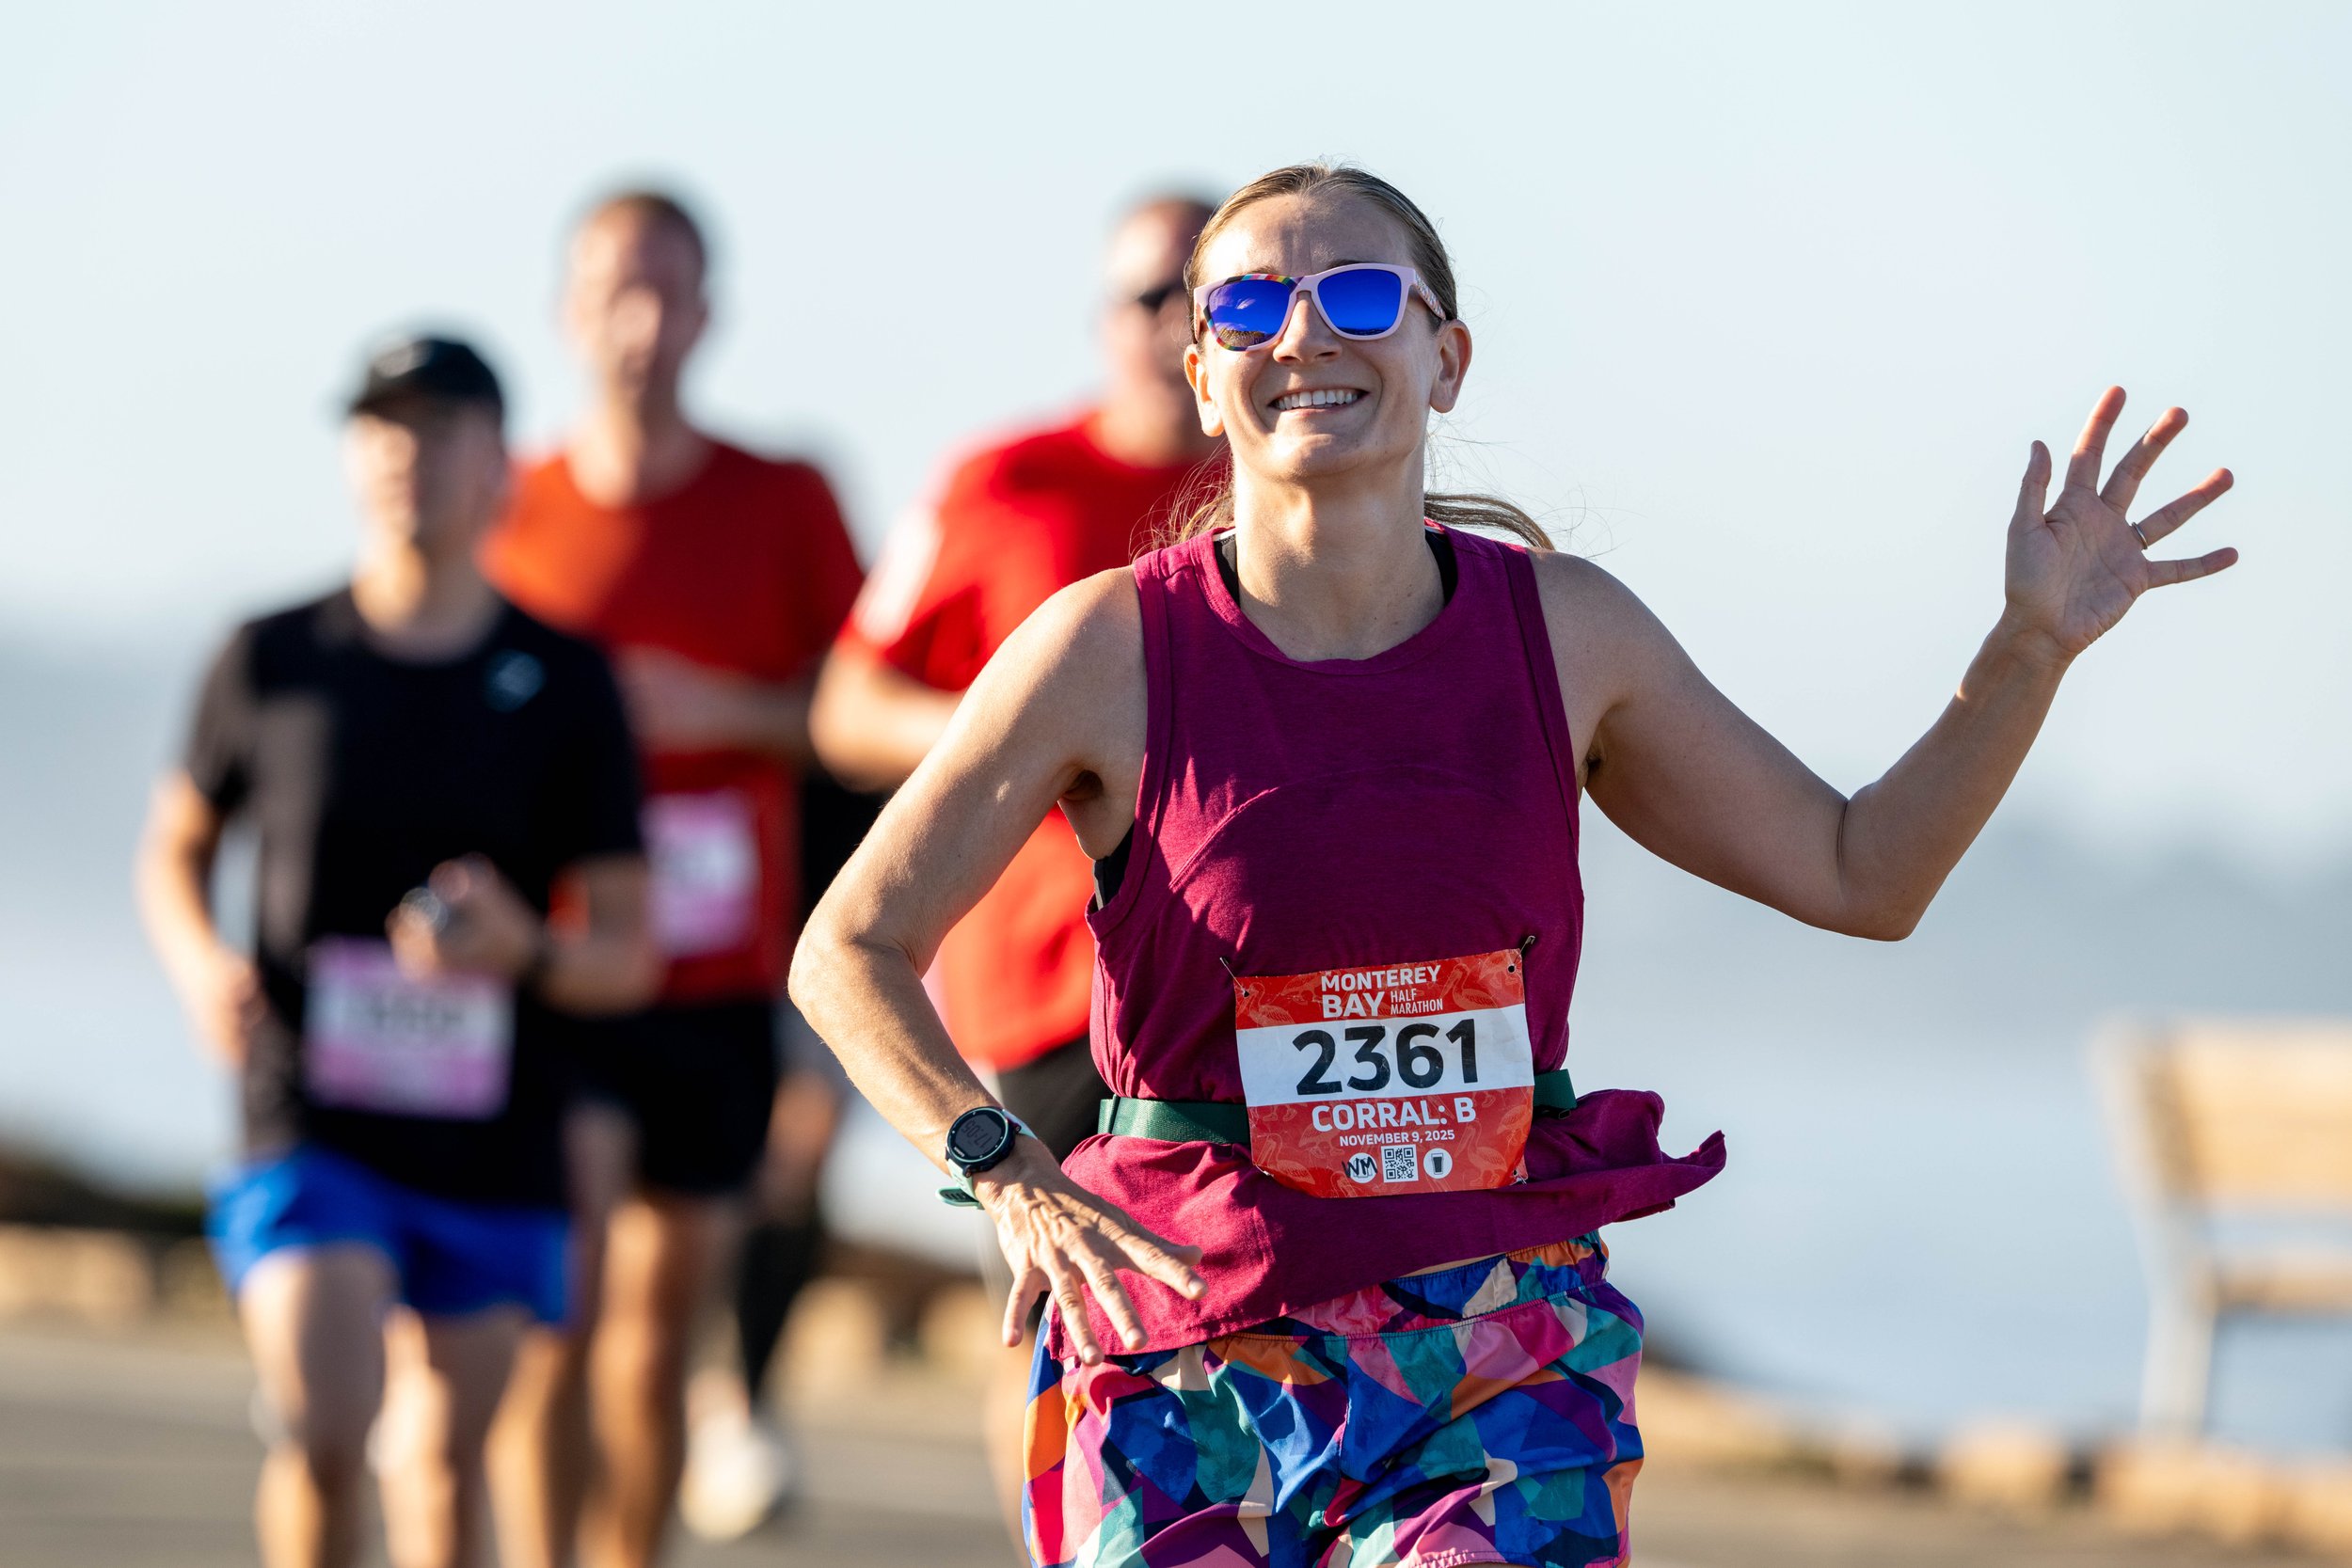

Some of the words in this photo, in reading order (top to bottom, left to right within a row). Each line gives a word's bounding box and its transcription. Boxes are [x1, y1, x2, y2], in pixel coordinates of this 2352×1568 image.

[1321, 965, 1440, 992] MONTEREY
[1322, 991, 1385, 1018] BAY
[1391, 989, 1417, 1003] HALF
[1391, 998, 1443, 1015] MARATHON
[1292, 1019, 1478, 1095] 2361
[1311, 1100, 1447, 1132] CORRAL:
[1454, 1097, 1476, 1123] B
[1340, 1132, 1409, 1147] NOVEMBER
[1411, 1132, 1423, 1144] 9,
[1425, 1130, 1455, 1141] 2025
